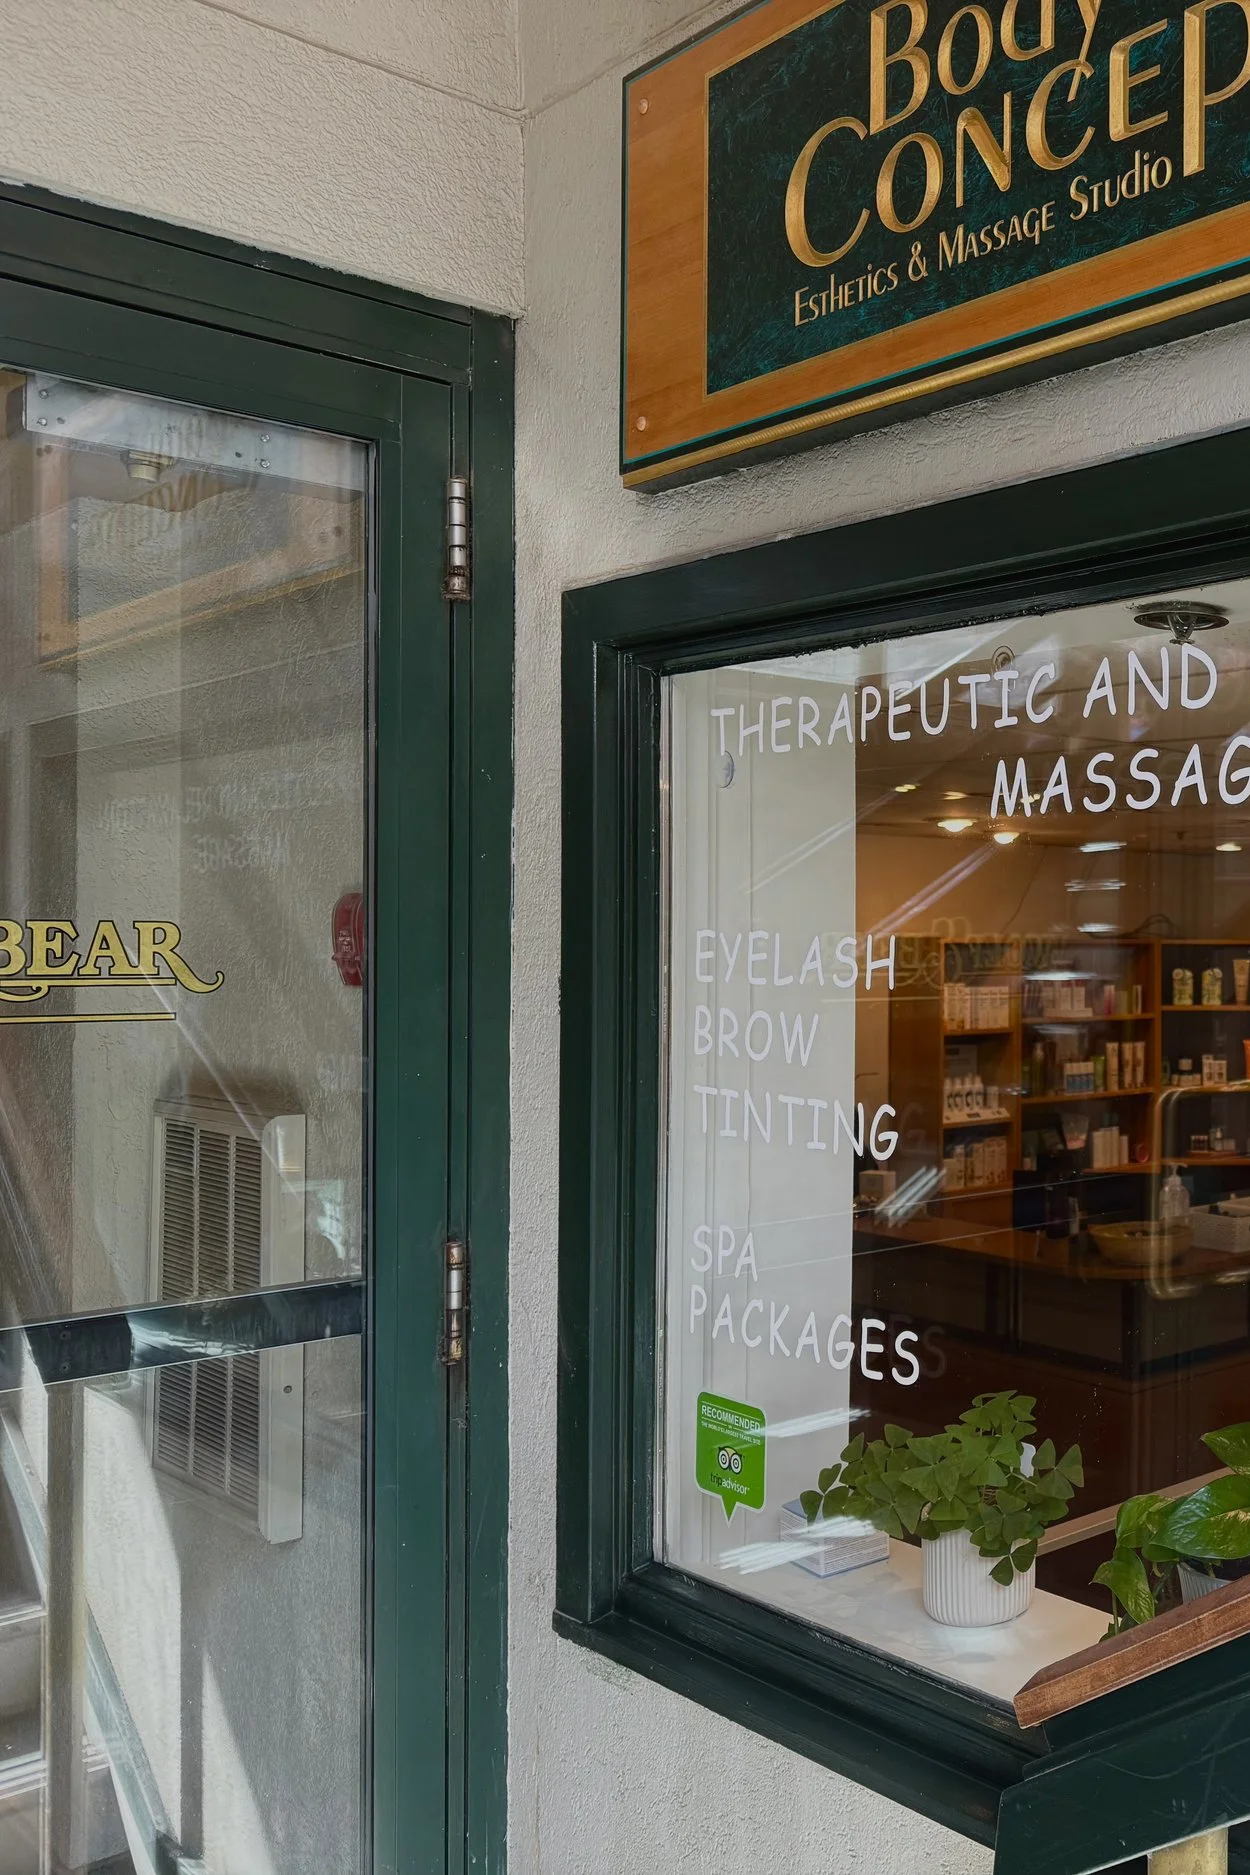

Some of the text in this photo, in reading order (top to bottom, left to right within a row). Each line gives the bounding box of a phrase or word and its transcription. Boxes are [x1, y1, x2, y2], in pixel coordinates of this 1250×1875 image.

[907, 240, 929, 281] &
[710, 663, 1056, 756] THERAPEUTIC
[1083, 644, 1218, 718] AND
[0, 919, 225, 994] BEAR
[694, 929, 896, 991] EYELASH
[693, 1005, 820, 1067] BROW
[693, 1084, 899, 1161] TINTING
[690, 1224, 759, 1282] SPA
[689, 1284, 920, 1386] PACKAGES
[701, 1404, 761, 1433] RECOMMENDED
